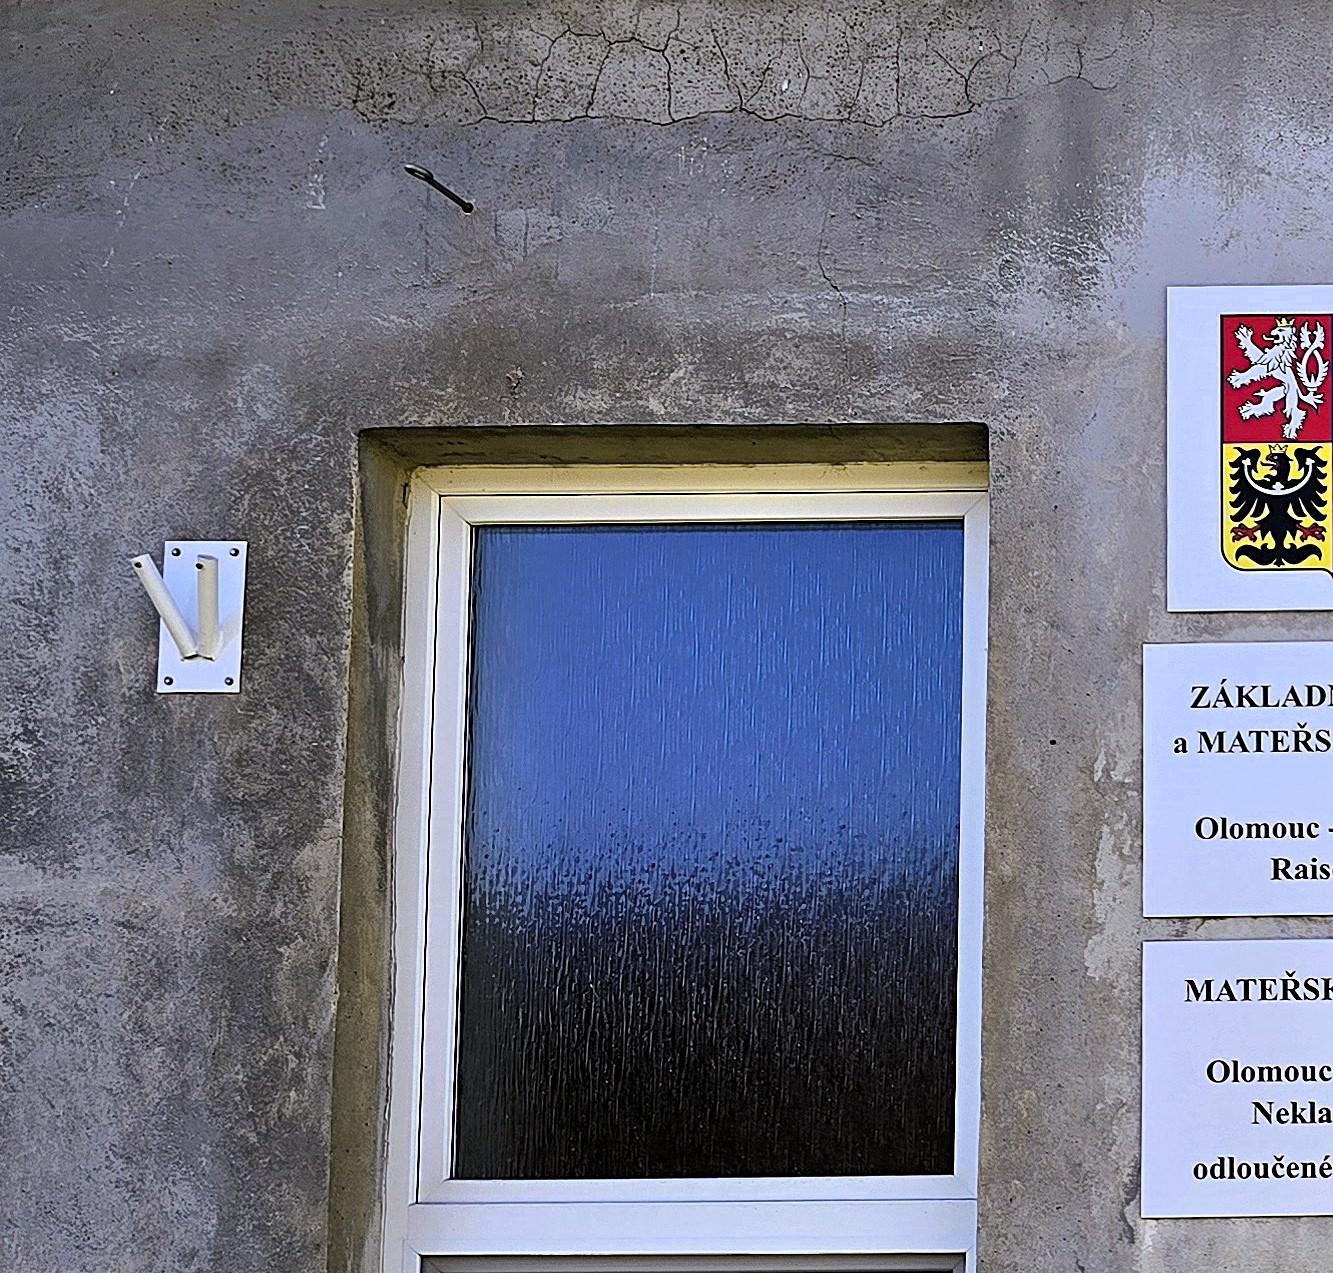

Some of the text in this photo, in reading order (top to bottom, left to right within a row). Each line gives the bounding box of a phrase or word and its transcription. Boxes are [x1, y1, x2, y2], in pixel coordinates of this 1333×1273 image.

[1174, 738, 1188, 753] a
[1196, 817, 1319, 839] Olomouc
[1207, 1060, 1332, 1083] Olomouc
[1194, 1155, 1332, 1180] odloučené
